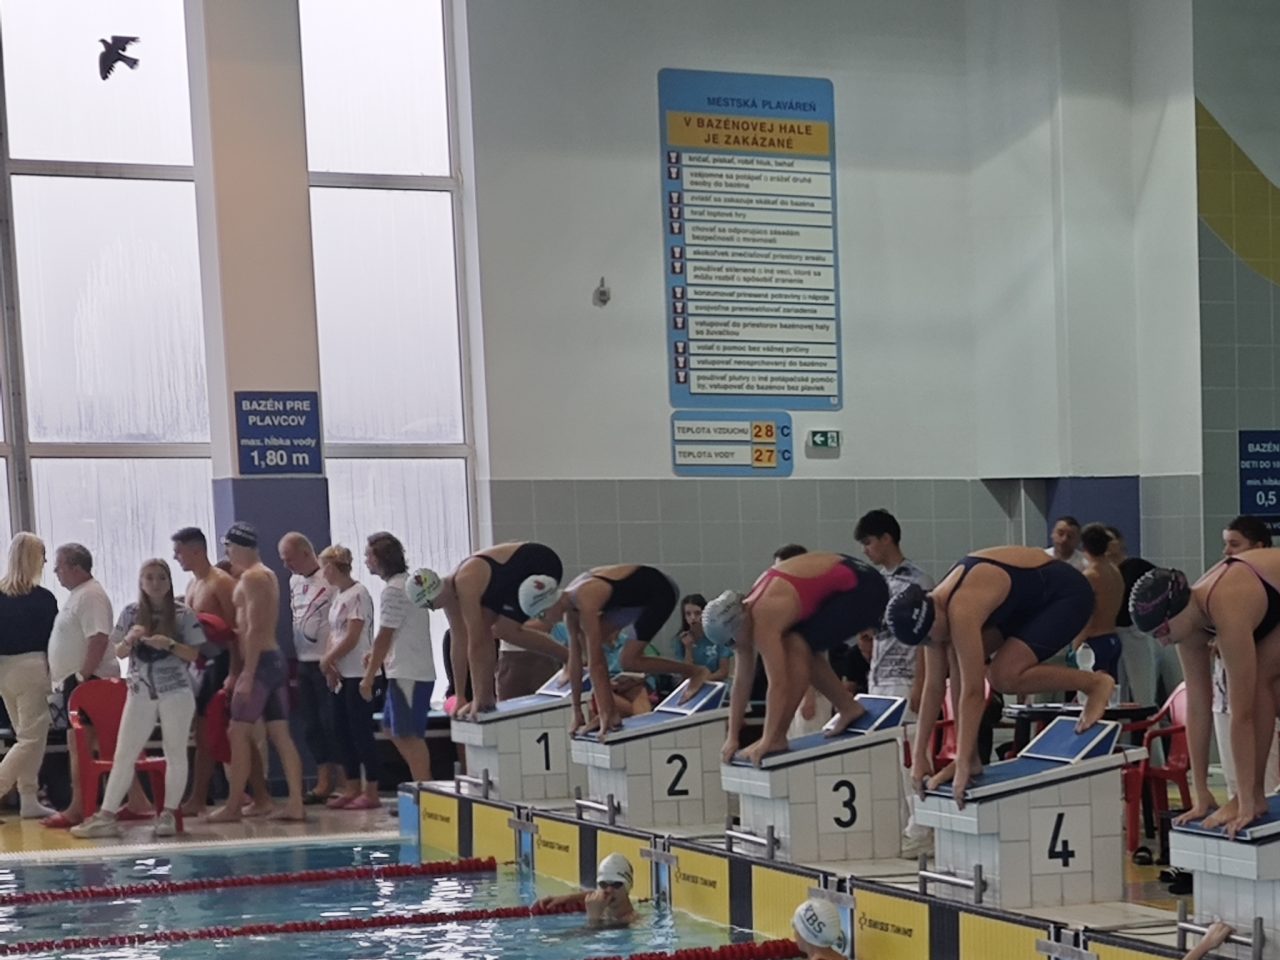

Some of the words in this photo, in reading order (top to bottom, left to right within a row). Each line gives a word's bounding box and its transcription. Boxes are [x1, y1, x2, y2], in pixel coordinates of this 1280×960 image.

[684, 116, 692, 126] V
[696, 117, 774, 134] BAZÉNOVEJ
[779, 124, 813, 135] HALE
[704, 133, 721, 144] JE
[724, 134, 793, 149] ZAKÁZANÉ
[242, 398, 283, 411] BAZÉN
[286, 400, 311, 411] PRE
[248, 415, 306, 426] PLAVCOV
[677, 426, 711, 434] TEPLOTA
[713, 427, 749, 435] VZDUCHU
[754, 424, 774, 438] 28
[292, 438, 316, 448] vody
[1248, 442, 1280, 452] BAZÉN
[250, 450, 288, 468] 1,80
[292, 452, 310, 466] m
[714, 451, 735, 459] VODY
[754, 448, 775, 462] 27
[1256, 490, 1277, 507] 0,5
[536, 732, 552, 771] 1
[666, 754, 690, 798] 2
[832, 780, 857, 829] 3
[1047, 812, 1076, 868] 4
[803, 904, 826, 934] KBS
